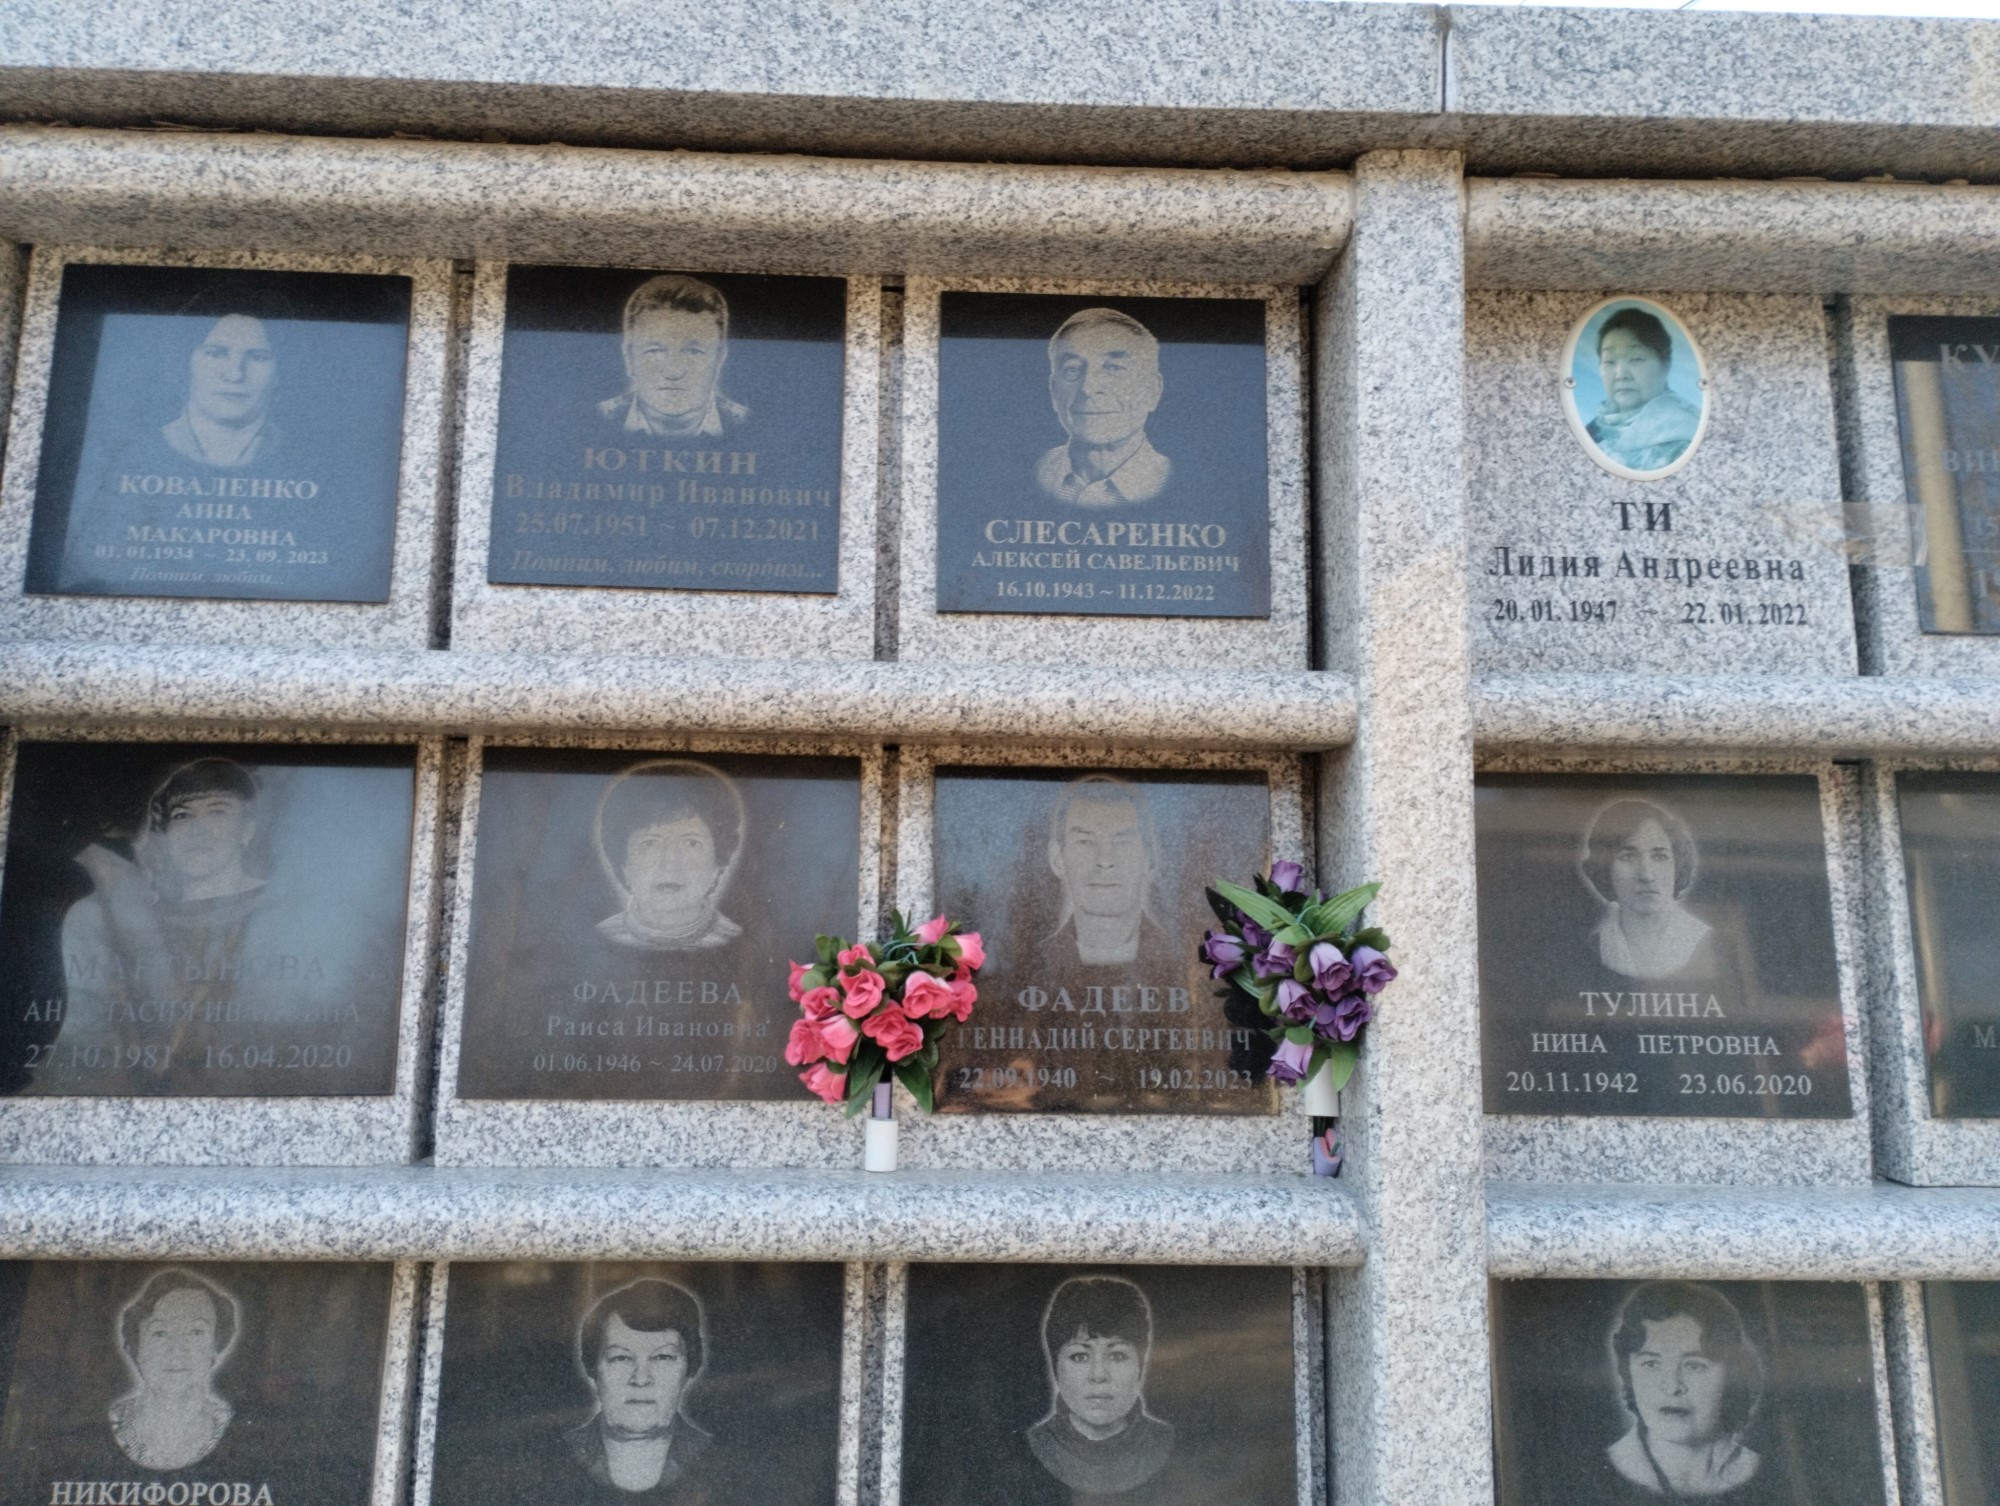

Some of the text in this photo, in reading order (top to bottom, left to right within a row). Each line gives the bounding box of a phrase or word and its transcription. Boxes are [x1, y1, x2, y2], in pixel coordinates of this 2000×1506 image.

[583, 447, 760, 474] ЮТКИН
[118, 474, 320, 500] КОВАЛЕНКО
[506, 473, 831, 508] Владимир Иванович
[176, 503, 253, 520] АННА
[1612, 500, 1674, 532] ТИ
[126, 526, 297, 546] МАКАРОВНА
[516, 512, 648, 537] 25.07.1951
[690, 515, 820, 542] 07.12.2021
[984, 519, 1227, 548] СЛЕСАРЕНКО
[971, 549, 1240, 572] АЛЕКСЕЙ САВЕЛЬЕВИЧ
[1488, 546, 1806, 588] Лидия Андреевна
[996, 581, 1095, 599] 16.10.1943
[1118, 583, 1216, 602] 11.12.2022
[572, 980, 743, 1007] ФАДЕЕВА
[1017, 985, 1190, 1017] ФАДЕЕВ
[1579, 991, 1727, 1018] ТУЛИНА
[23, 999, 195, 1023] АНТАСИЯ
[547, 1015, 625, 1037] Раиса
[957, 1022, 1250, 1051] ГЕННАДИЙ СЕРГЕЕВИЧ
[24, 1044, 353, 1069] 27.10.1981 16.04.2020
[1530, 1032, 1781, 1056] НИНА ПЕТРОВНА
[533, 1053, 641, 1073] 01.06.1946
[670, 1054, 777, 1073] 24.07.2020
[959, 1067, 1077, 1090] 22.09.1940
[1138, 1068, 1252, 1090] 19.02.2023
[1507, 1071, 1812, 1096] 20.11.1942 23.06.2020
[48, 1480, 275, 1506] НИКИФОРОВА
